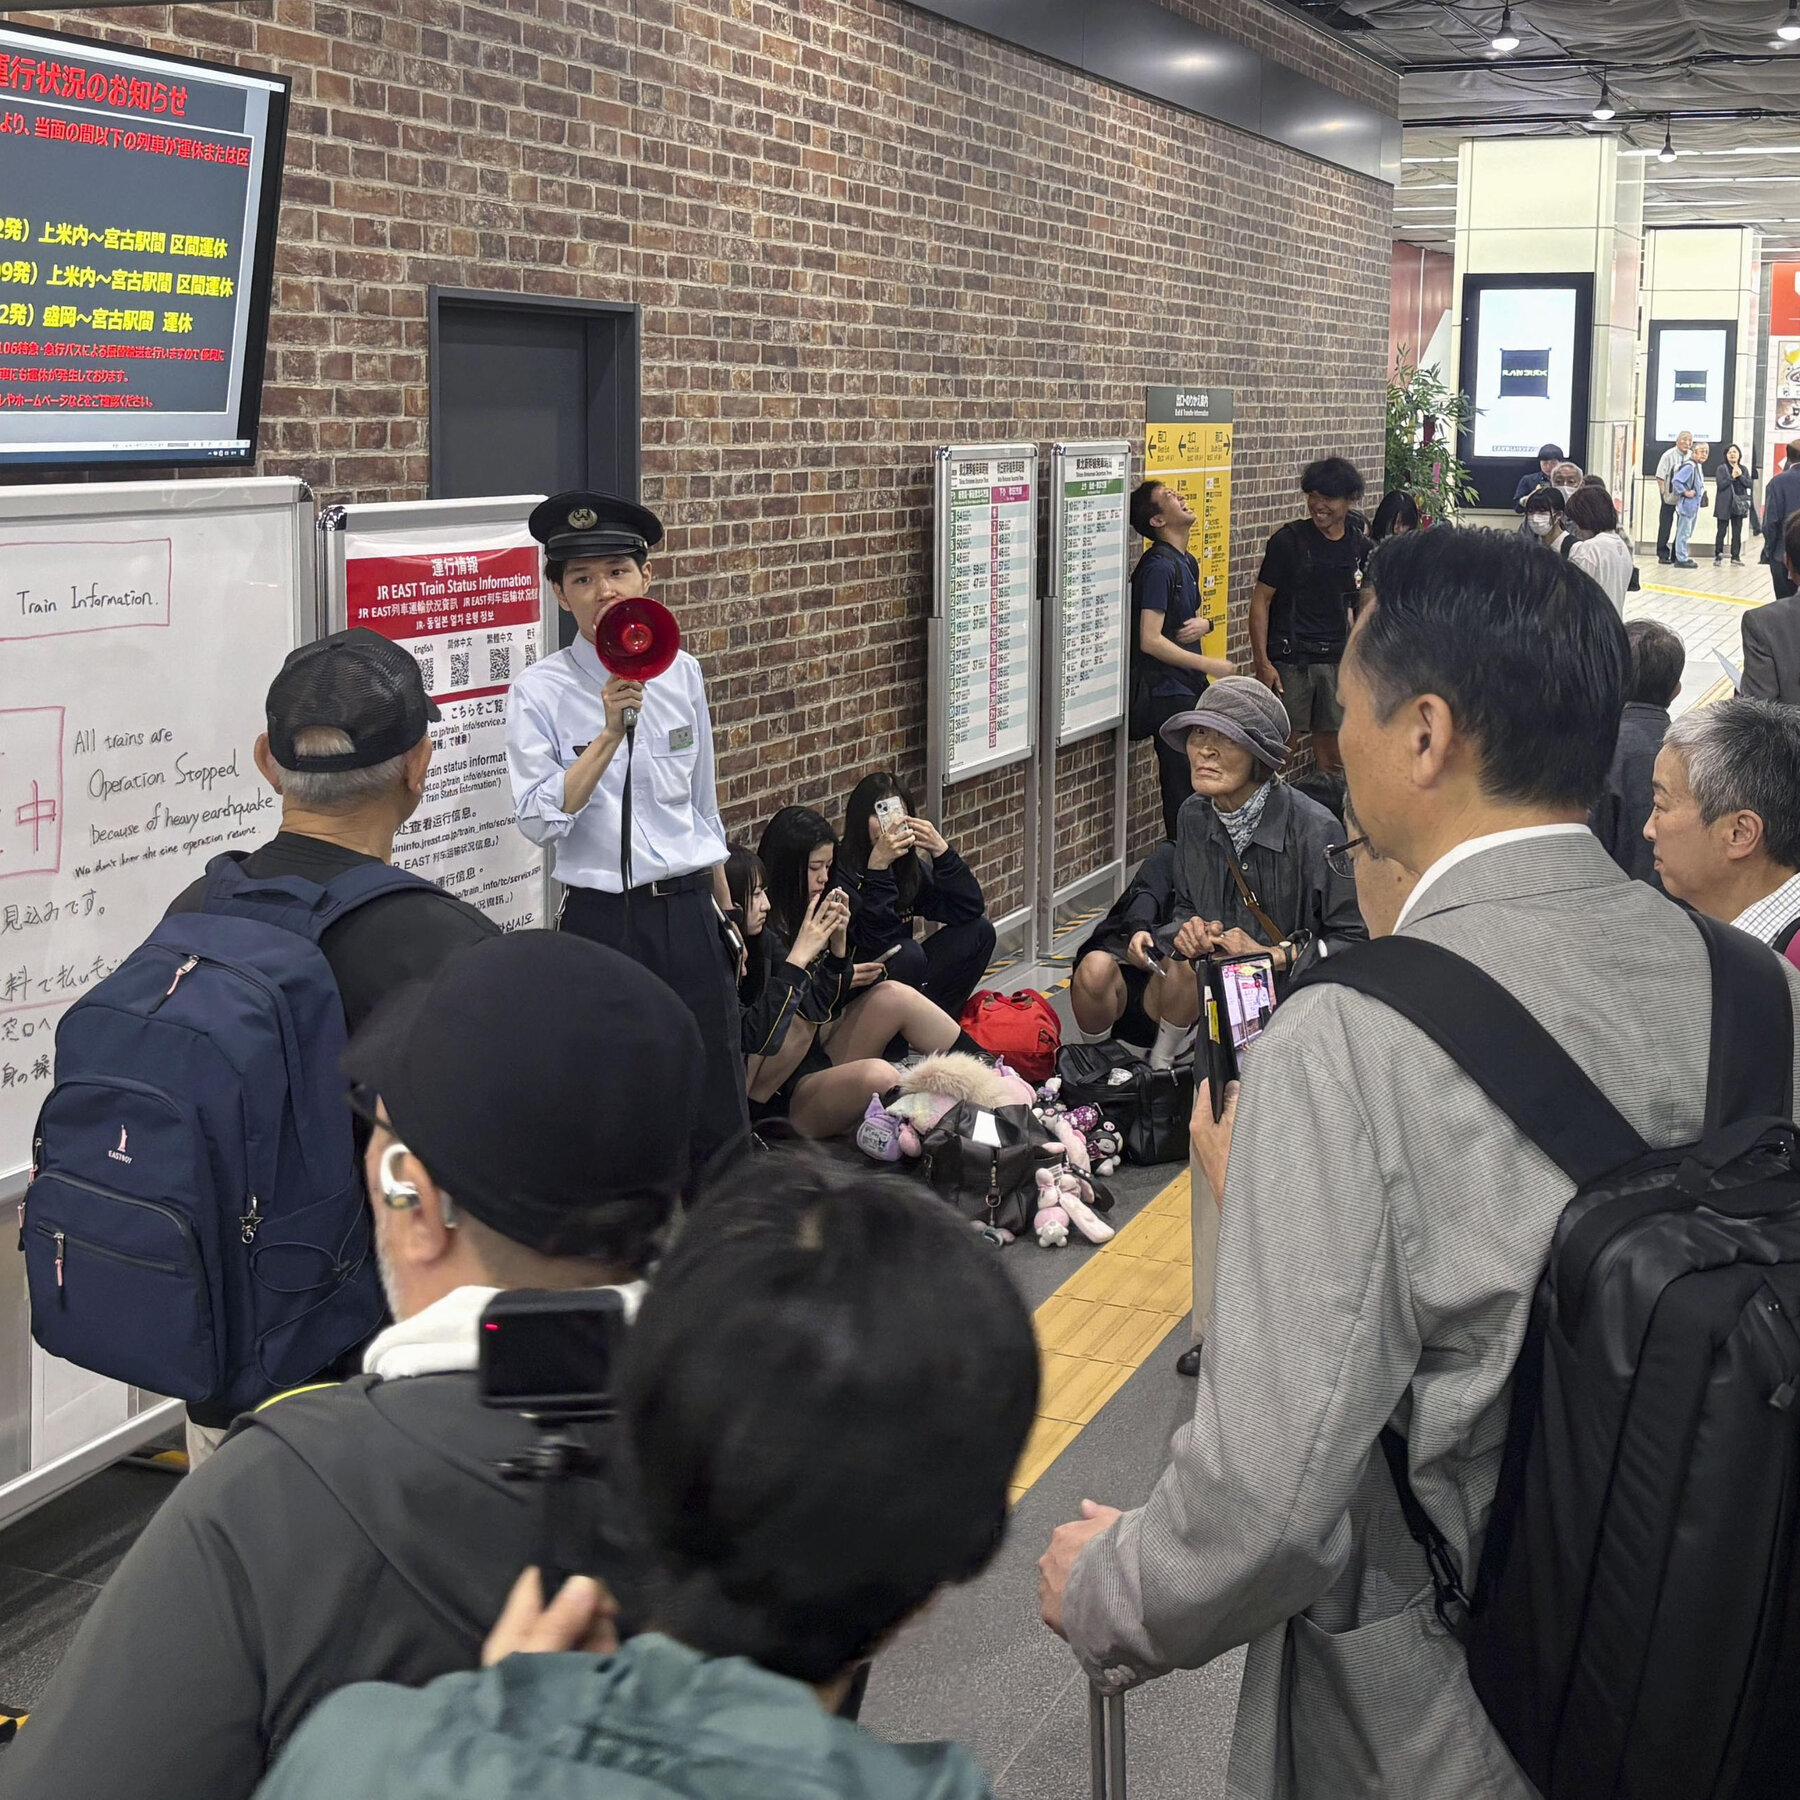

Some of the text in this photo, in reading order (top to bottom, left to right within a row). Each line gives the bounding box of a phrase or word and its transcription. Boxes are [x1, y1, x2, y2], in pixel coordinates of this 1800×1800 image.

[169, 234, 229, 259] 区間運休
[0, 261, 38, 285] 9発）
[176, 272, 234, 297] 区間運休
[162, 311, 193, 333] 運休
[432, 556, 479, 577] 運行情報
[17, 582, 158, 615] Train Information.
[377, 574, 532, 600] JR EAST Train Status Information
[358, 608, 369, 619] JR
[463, 598, 471, 608] JR
[414, 643, 434, 655] English
[74, 727, 173, 755] All trains are
[89, 747, 240, 801] Operation Stopped
[443, 760, 468, 774] status
[426, 793, 440, 803] Train
[440, 786, 459, 799] Status
[91, 787, 275, 846] because of heavy earthquake
[183, 833, 224, 856] operation
[404, 855, 431, 870] EAST
[1, 887, 105, 935] 見込みです。
